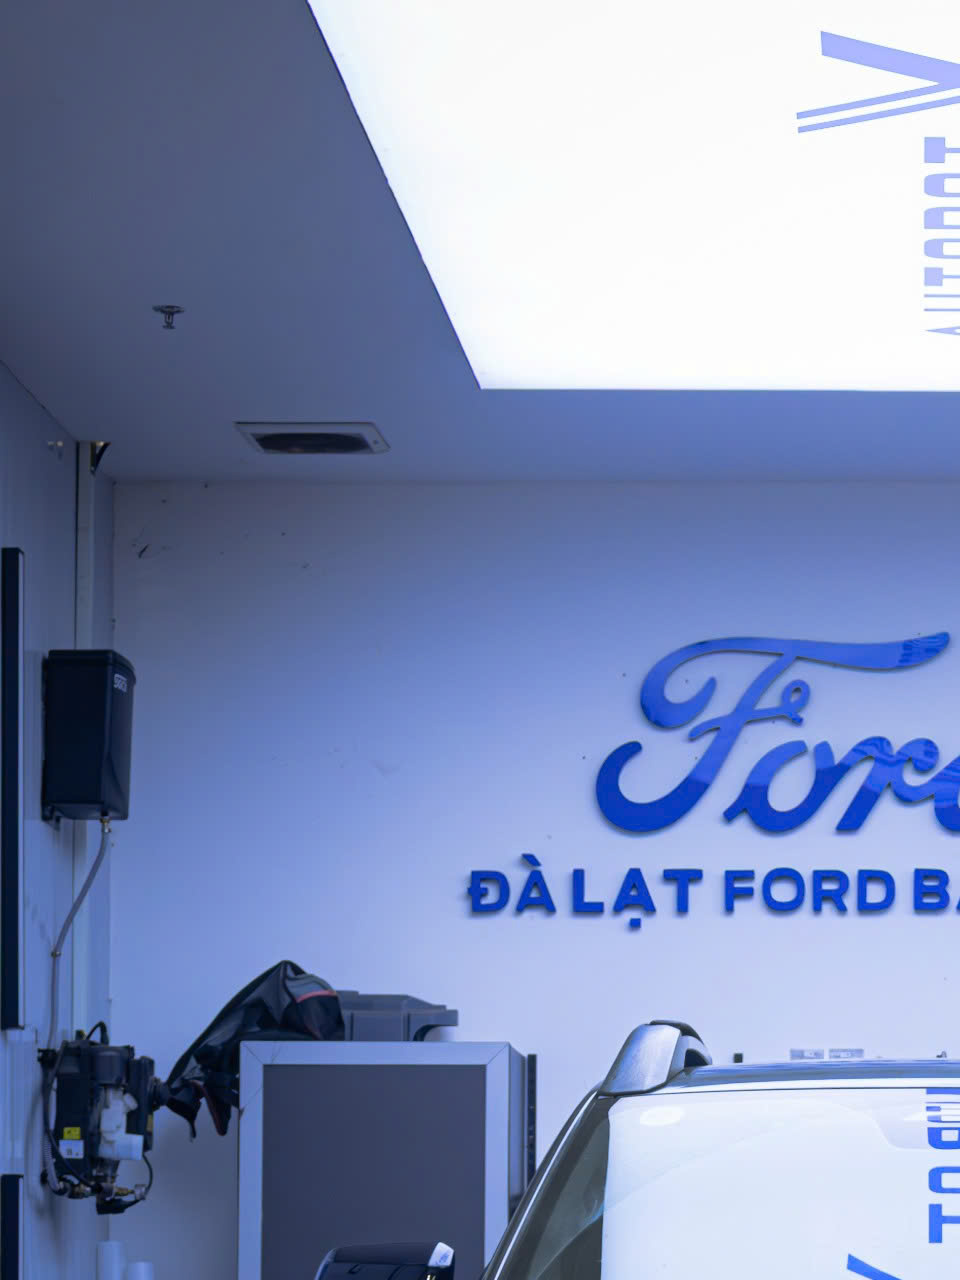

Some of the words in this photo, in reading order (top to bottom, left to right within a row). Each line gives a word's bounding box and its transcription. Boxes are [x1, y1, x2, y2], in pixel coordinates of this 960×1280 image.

[467, 853, 557, 914] ĐÀ
[572, 867, 704, 929] LẠT
[725, 867, 897, 914] FORD
